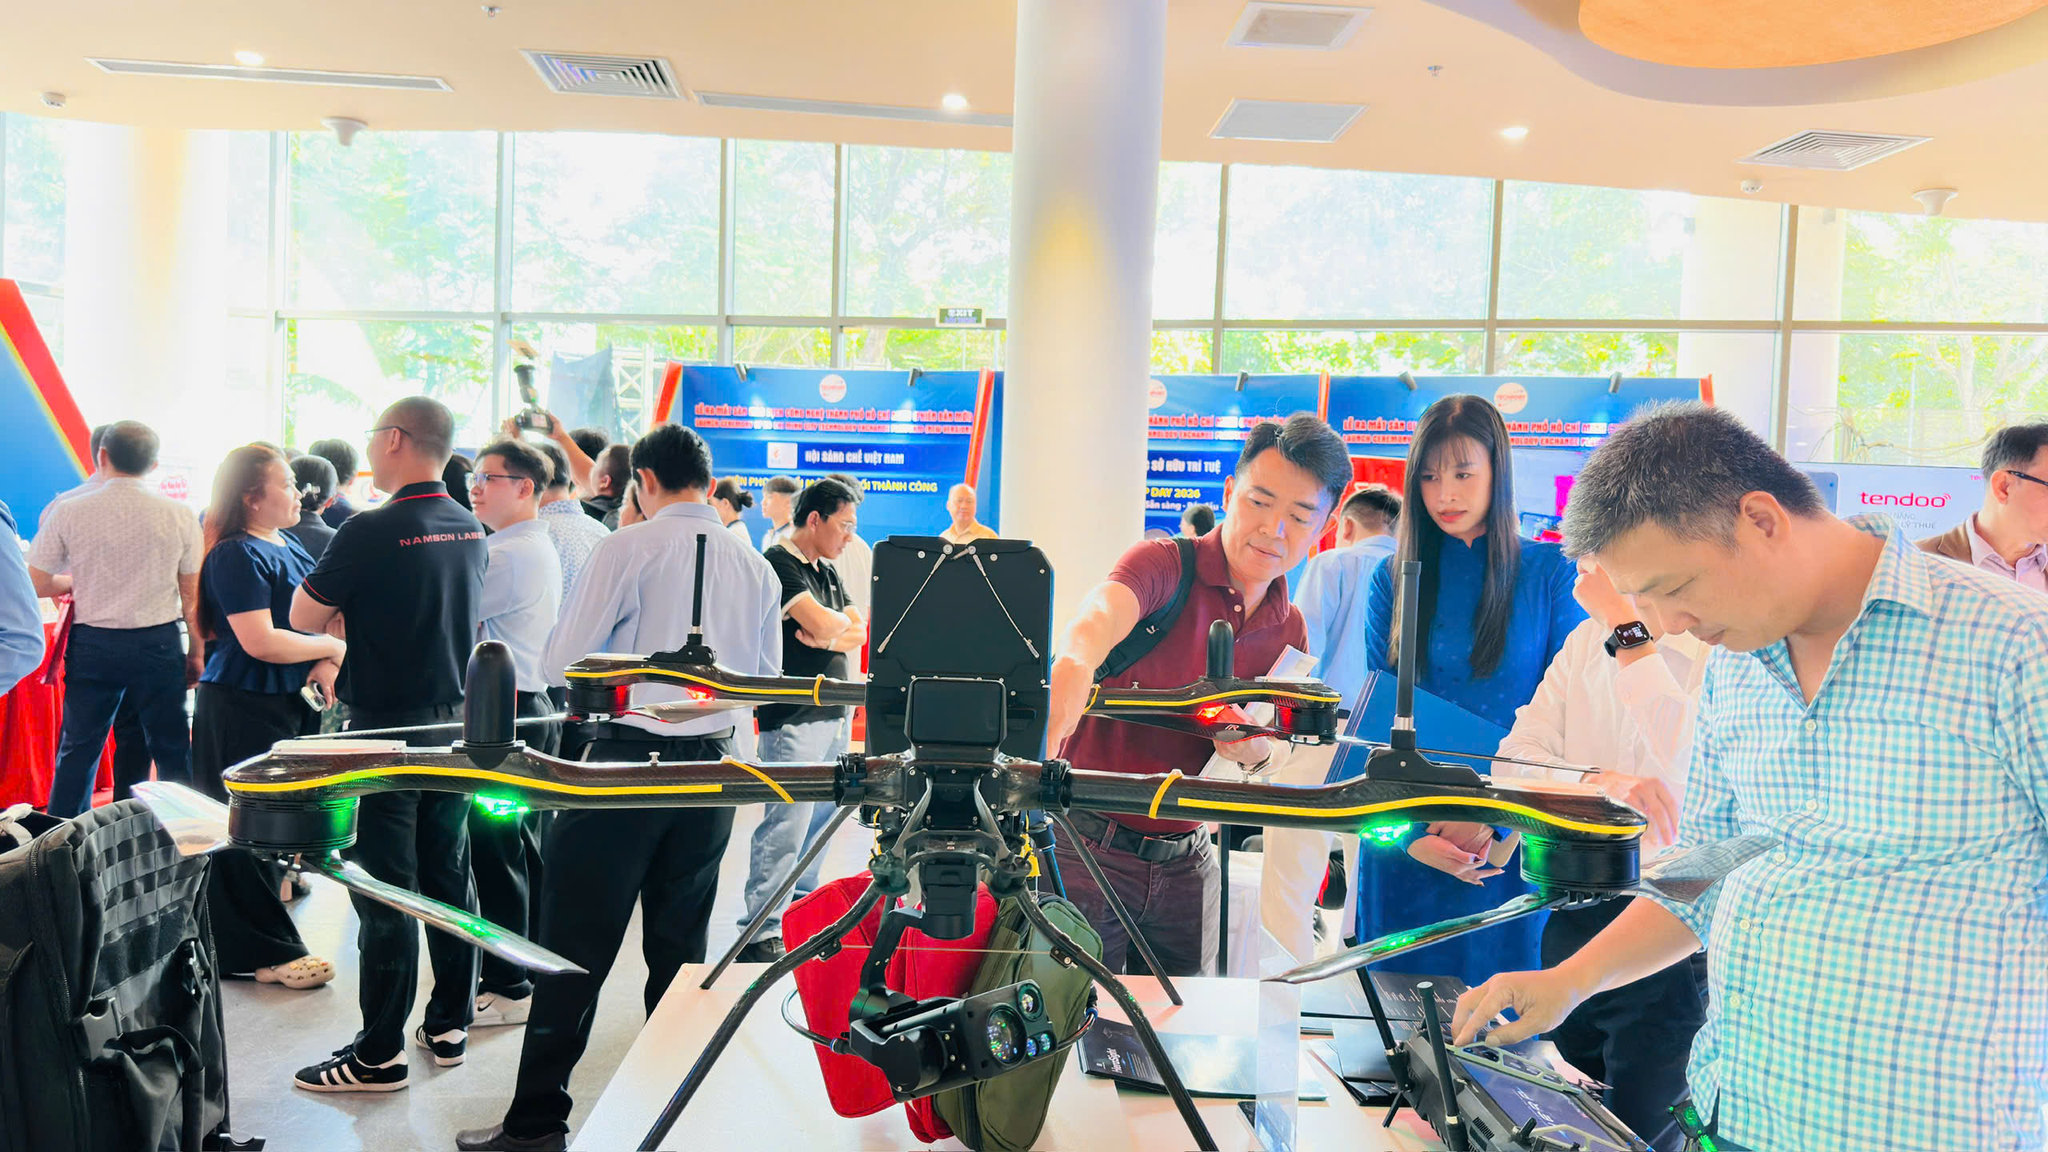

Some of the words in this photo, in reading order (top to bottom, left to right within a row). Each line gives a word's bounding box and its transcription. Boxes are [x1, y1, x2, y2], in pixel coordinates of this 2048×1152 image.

[948, 309, 975, 317] EXIT
[1354, 420, 1367, 431] RA
[1530, 418, 1548, 433] PHỐ
[1564, 420, 1580, 433] CHÍ
[805, 449, 820, 464] HỘI
[821, 449, 845, 464] SÁNG
[863, 450, 883, 466] VIỆT
[884, 453, 905, 465] NAM
[1187, 459, 1202, 473] TRÍ
[872, 479, 908, 491] THÀNH
[908, 480, 938, 493] CÔNG
[1151, 487, 1173, 498] DAY
[1860, 491, 1947, 508] tendoo
[399, 533, 456, 547] NAMSON
